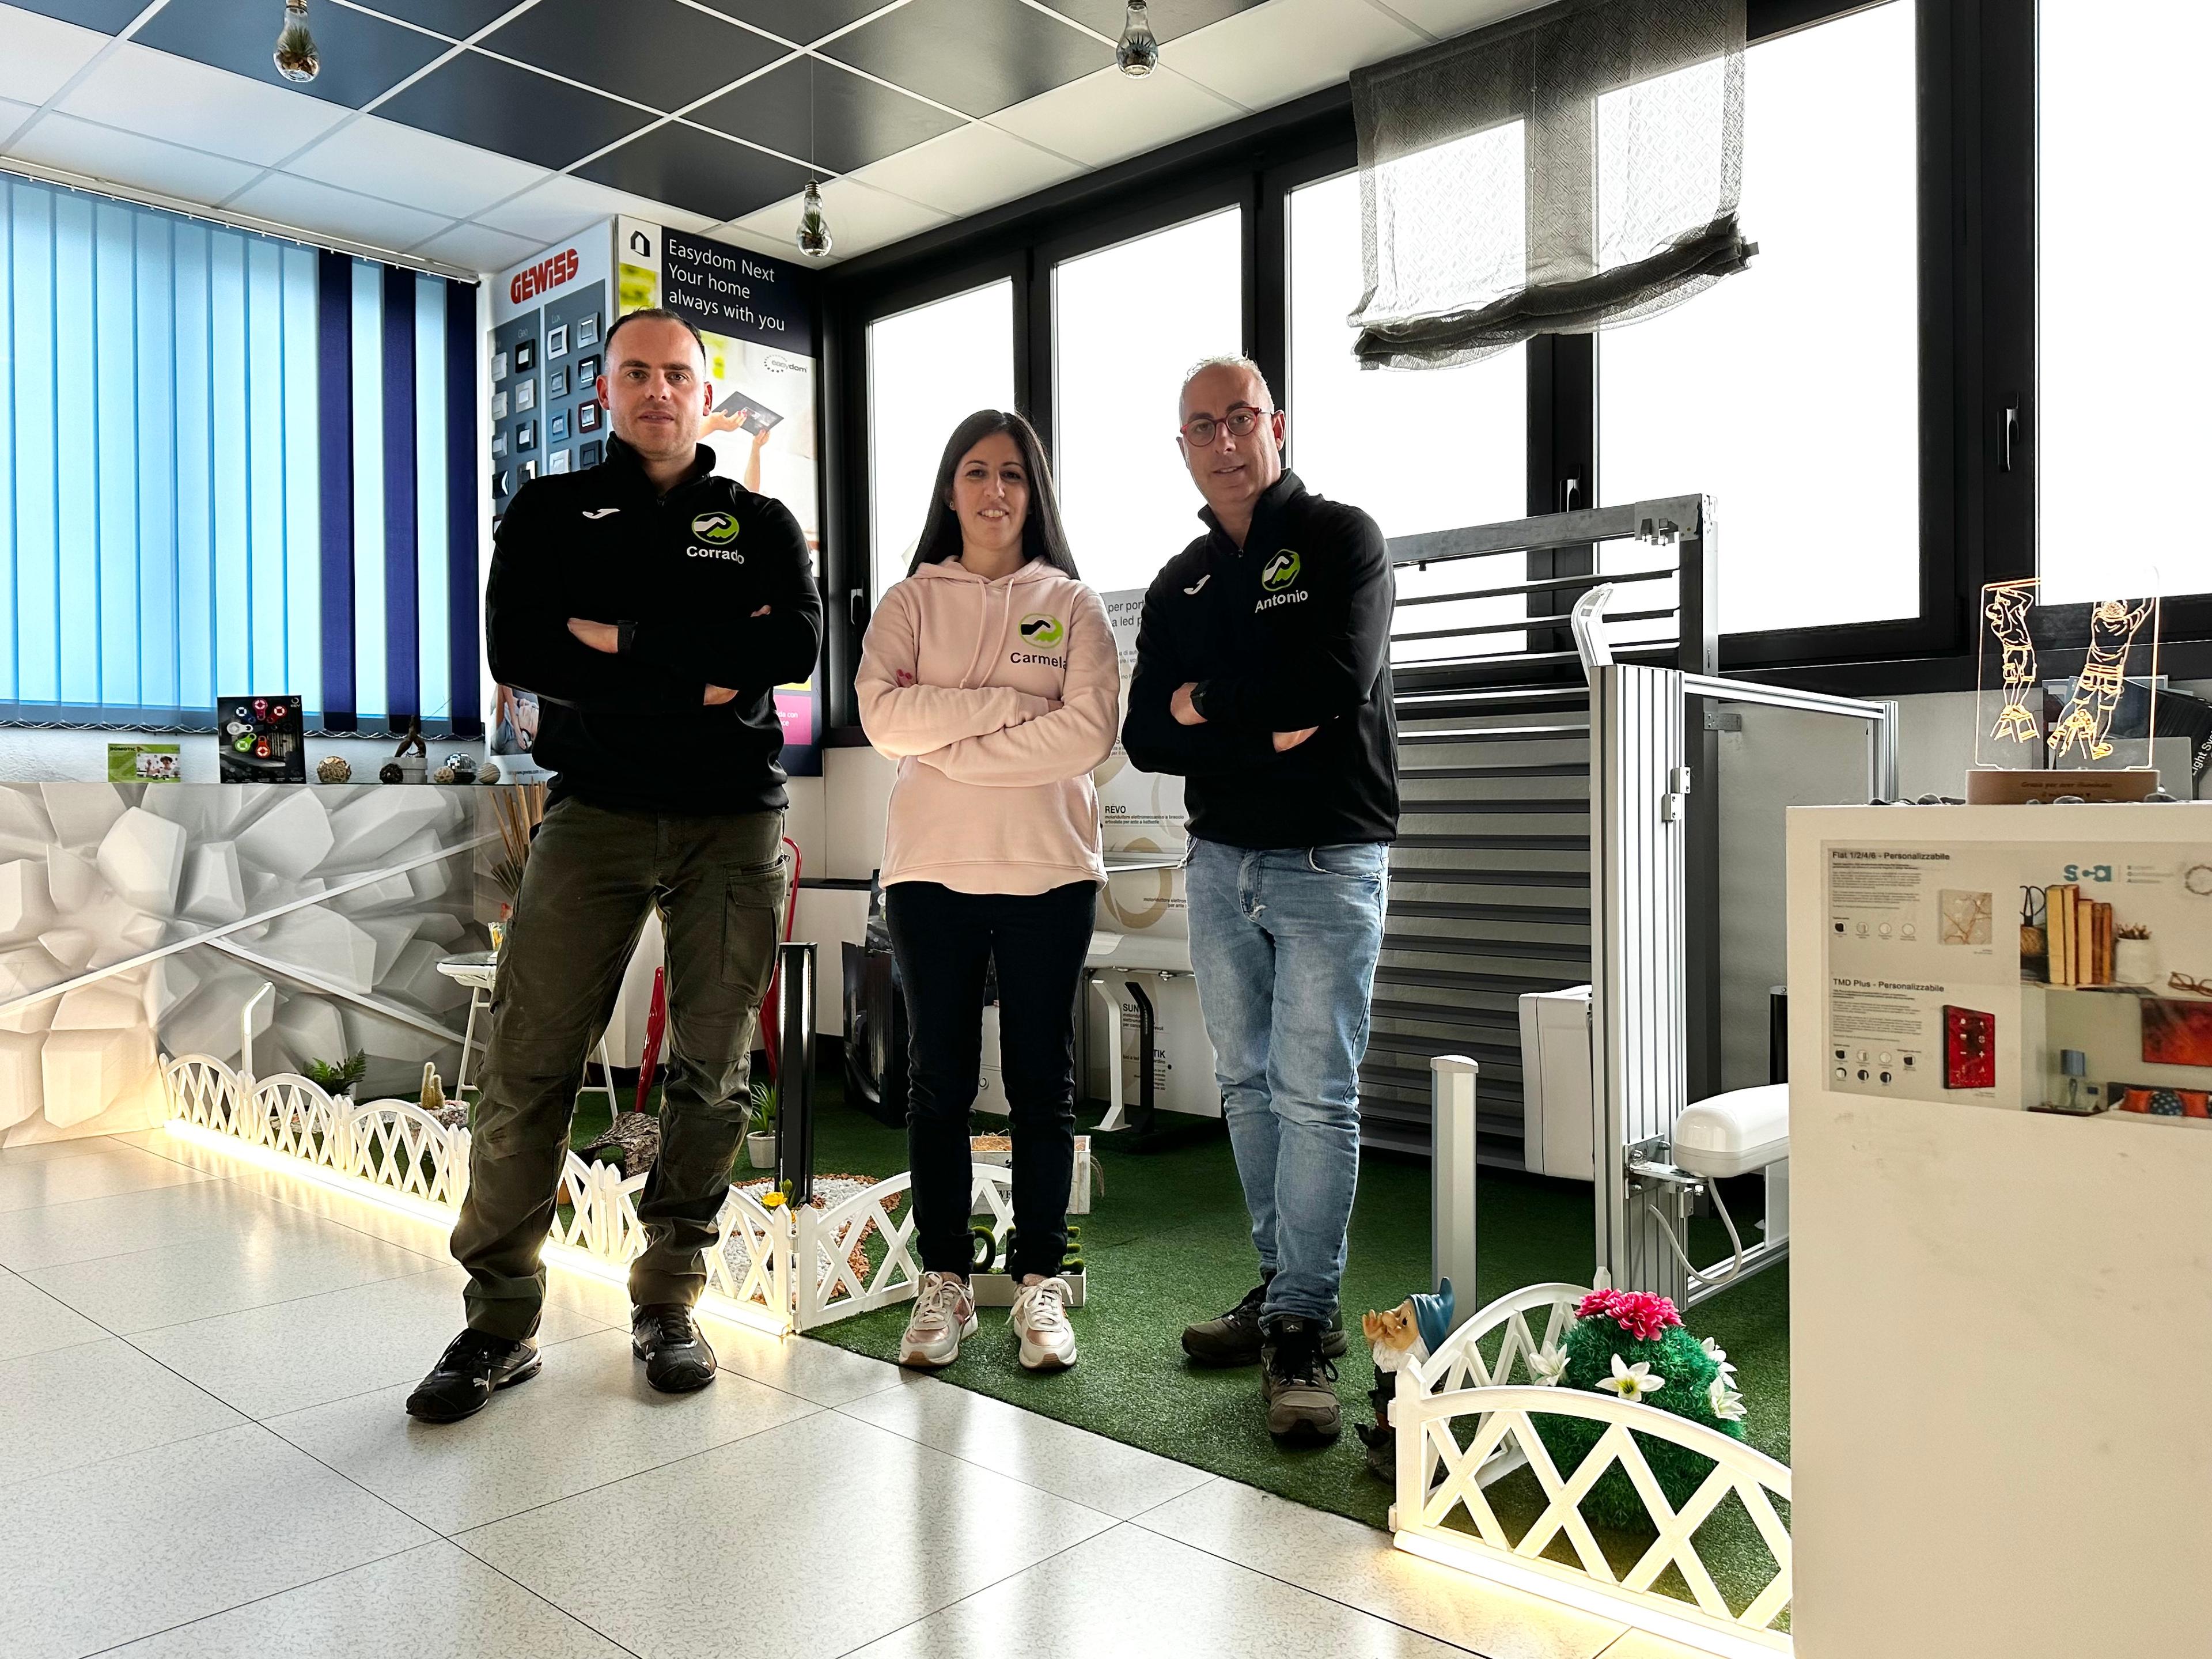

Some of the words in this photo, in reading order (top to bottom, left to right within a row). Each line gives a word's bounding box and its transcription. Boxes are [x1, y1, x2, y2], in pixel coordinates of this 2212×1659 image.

[669, 238, 736, 272] Easydom
[741, 259, 775, 282] Next
[510, 248, 579, 305] GEWISS
[669, 263, 703, 286] Your
[709, 273, 750, 299] home
[669, 289, 719, 316] always
[724, 305, 754, 323] with
[759, 315, 785, 331] you
[771, 360, 807, 373] easydom
[687, 546, 745, 565] Corrado
[1108, 603, 1123, 613] per
[1126, 600, 1145, 613] port
[1255, 589, 1308, 613] Antonio
[1120, 615, 1134, 626] led
[1878, 982, 1945, 992] Personalizzabile
[1154, 1049, 1165, 1058] TIK
